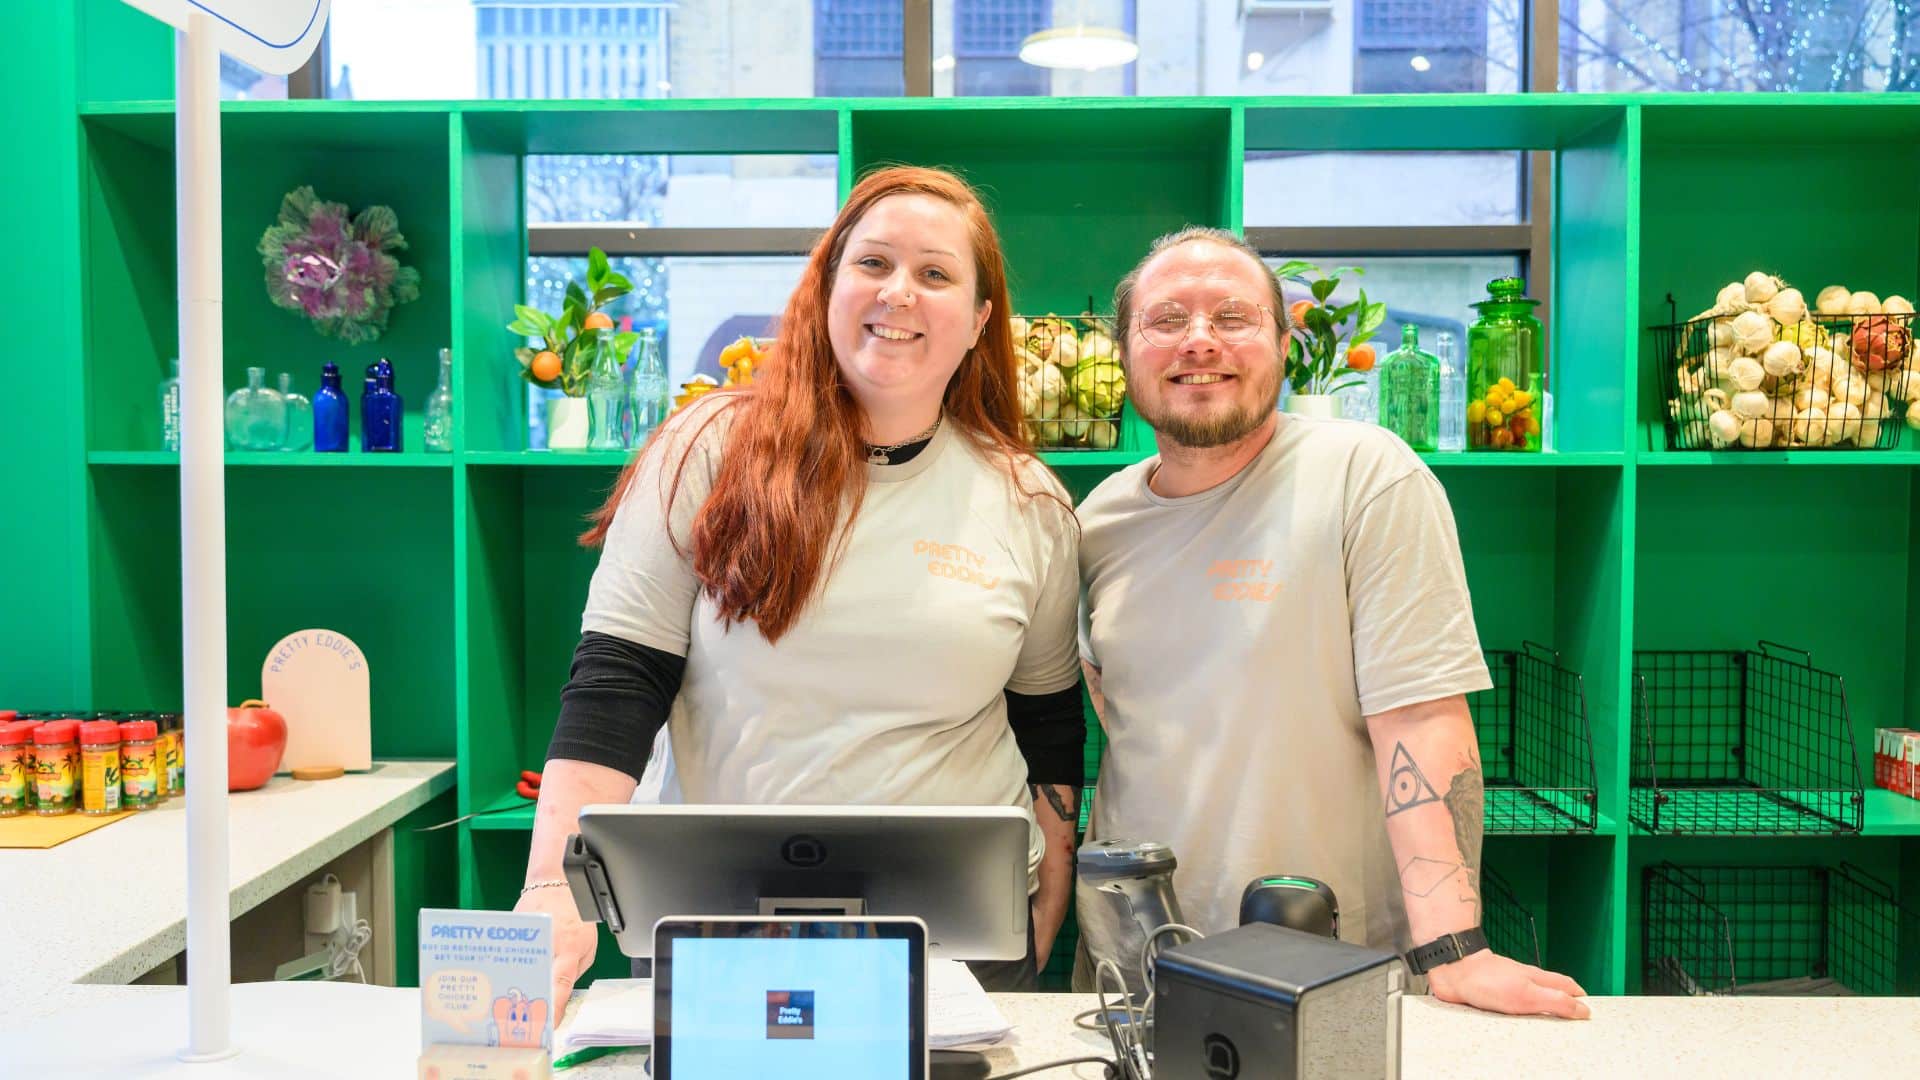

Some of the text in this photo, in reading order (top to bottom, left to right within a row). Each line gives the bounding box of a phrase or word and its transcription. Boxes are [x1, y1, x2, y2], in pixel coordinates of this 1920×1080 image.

[913, 540, 985, 567] PRETTY
[270, 633, 361, 673] PRETTY EDDIE'S
[431, 925, 484, 940] PRETTY
[440, 983, 476, 992] PRETTY
[438, 993, 478, 1001] CHICKEN
[779, 1006, 801, 1016] Pretty
[778, 1015, 803, 1025] Eddie's
